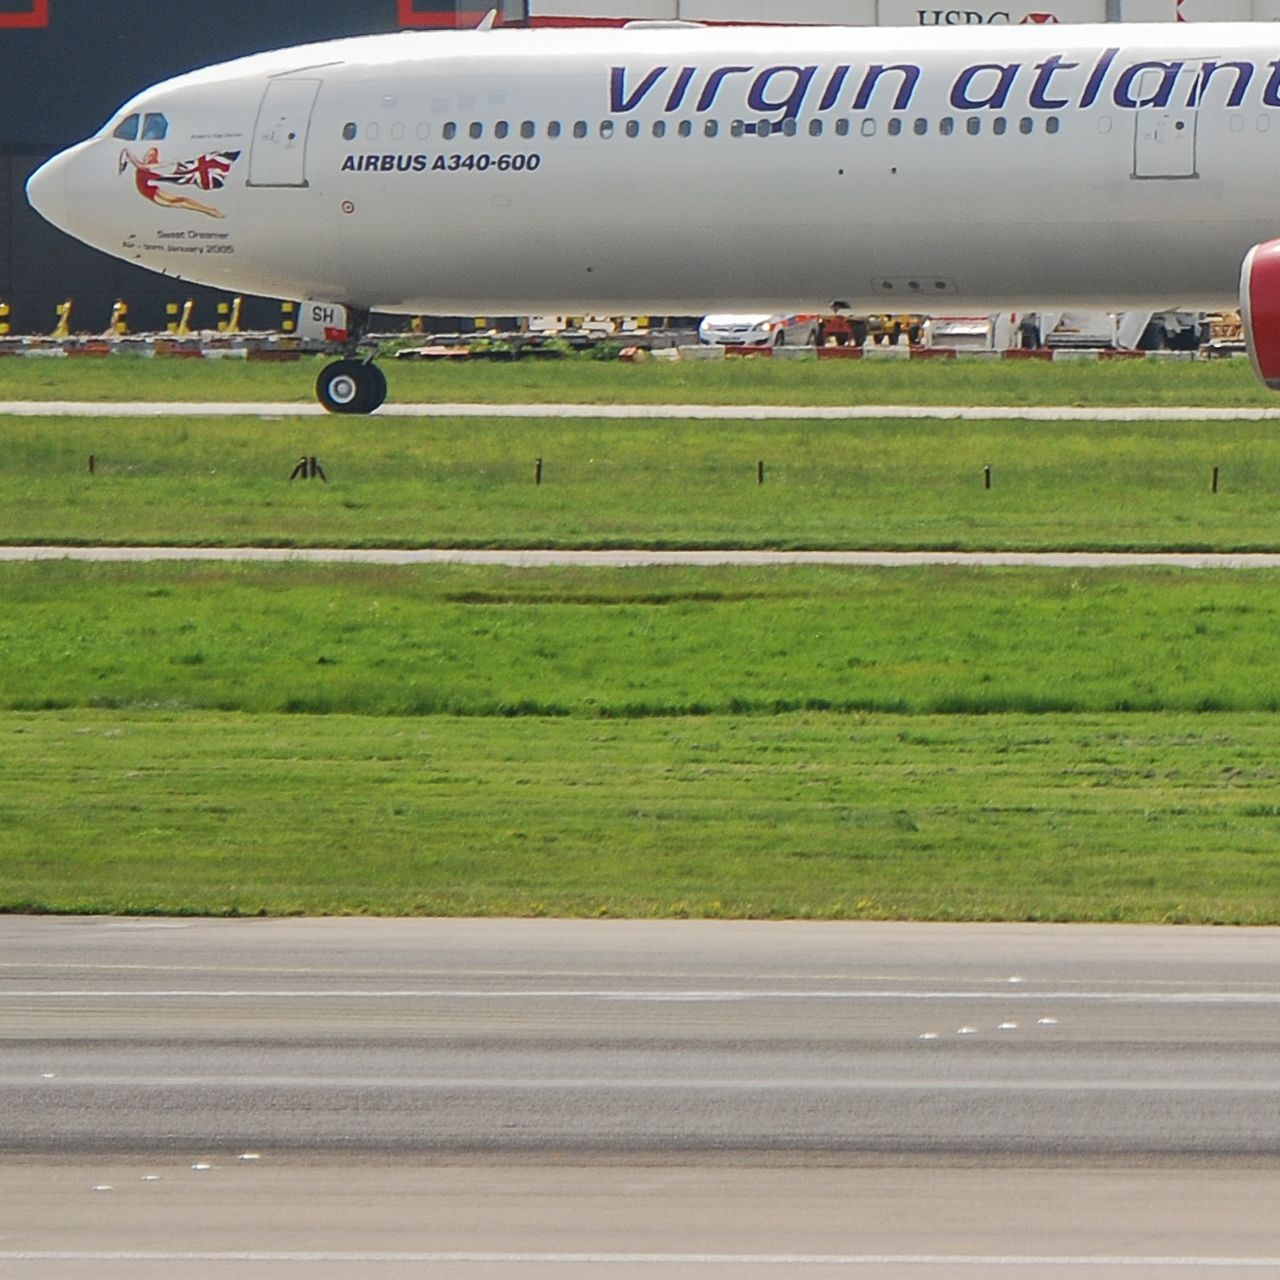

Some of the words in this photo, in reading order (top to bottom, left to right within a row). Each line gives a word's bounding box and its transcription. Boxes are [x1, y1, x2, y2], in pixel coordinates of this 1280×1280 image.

[609, 64, 922, 135] virgin
[341, 155, 428, 171] AIRBUS
[431, 153, 541, 171] A340-600
[312, 305, 335, 324] SH
